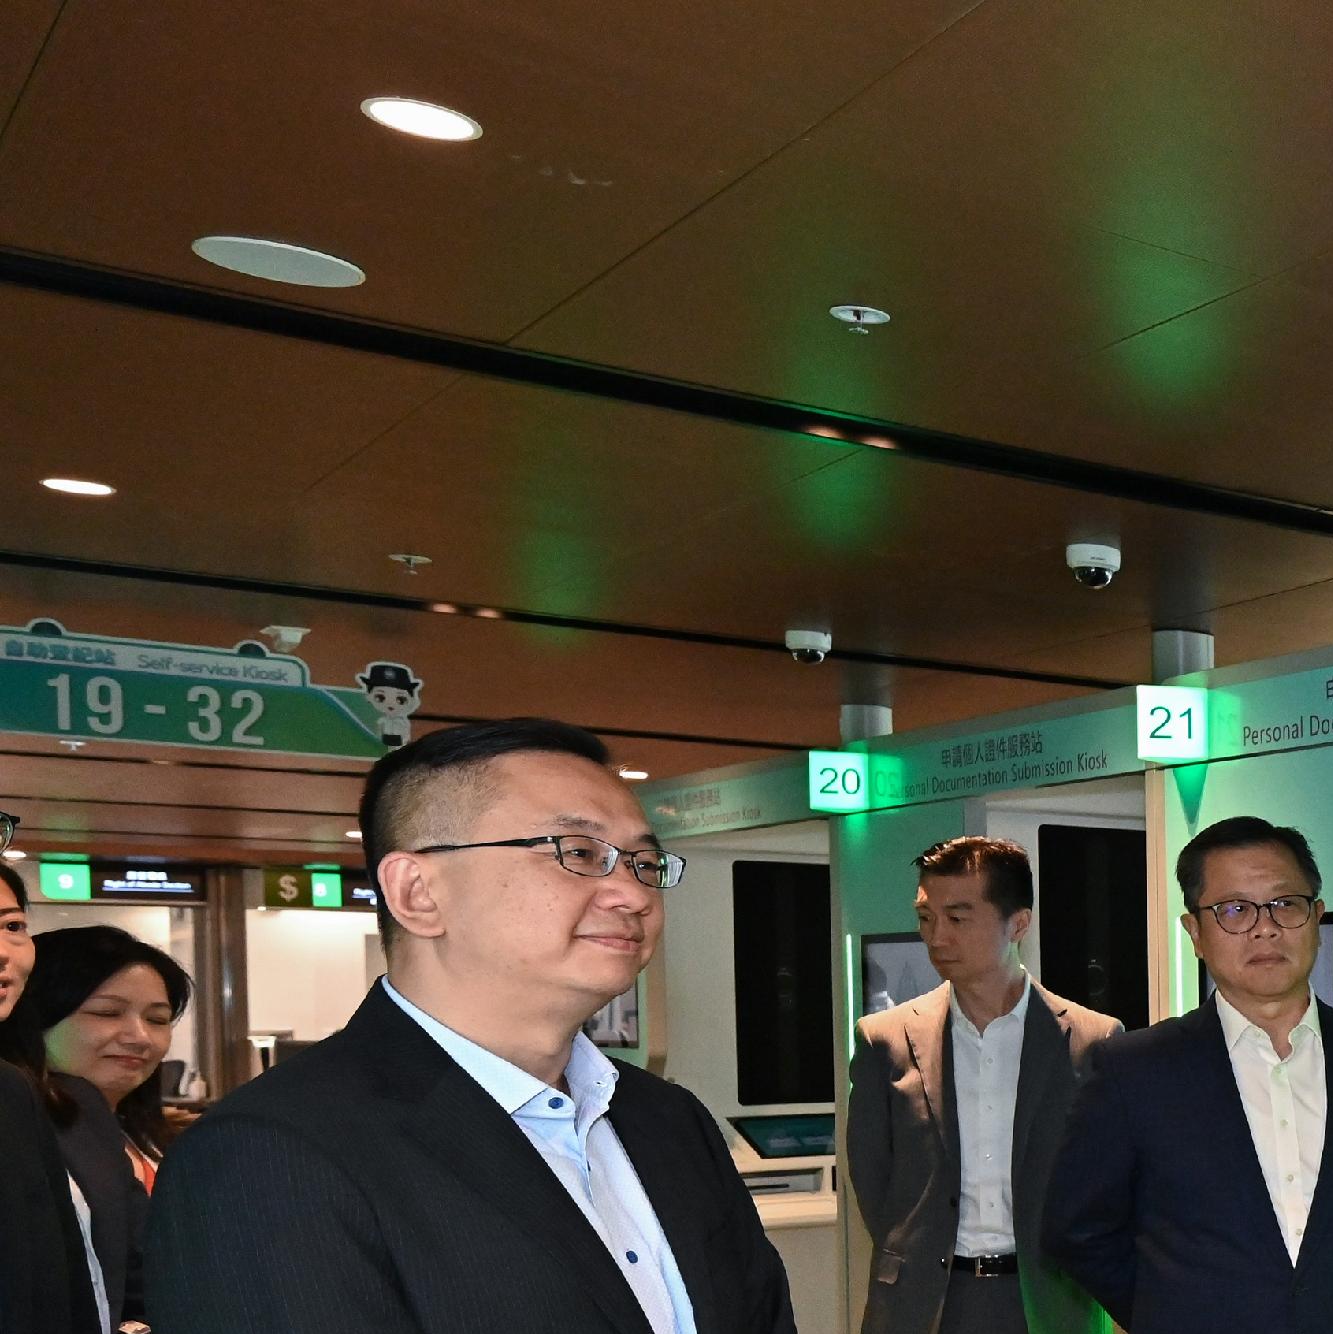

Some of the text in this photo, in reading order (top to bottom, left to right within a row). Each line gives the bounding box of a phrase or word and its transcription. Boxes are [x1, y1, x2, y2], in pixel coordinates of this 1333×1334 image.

[138, 654, 289, 683] Self-service Kiosk
[47, 673, 124, 735] 19
[187, 685, 265, 746] 32
[1149, 706, 1194, 740] 21
[1243, 716, 1304, 746] Personal
[819, 767, 861, 795] 20
[931, 766, 1008, 792] Documentation
[1010, 755, 1073, 783] Submission
[1077, 749, 1108, 771] Kiosk
